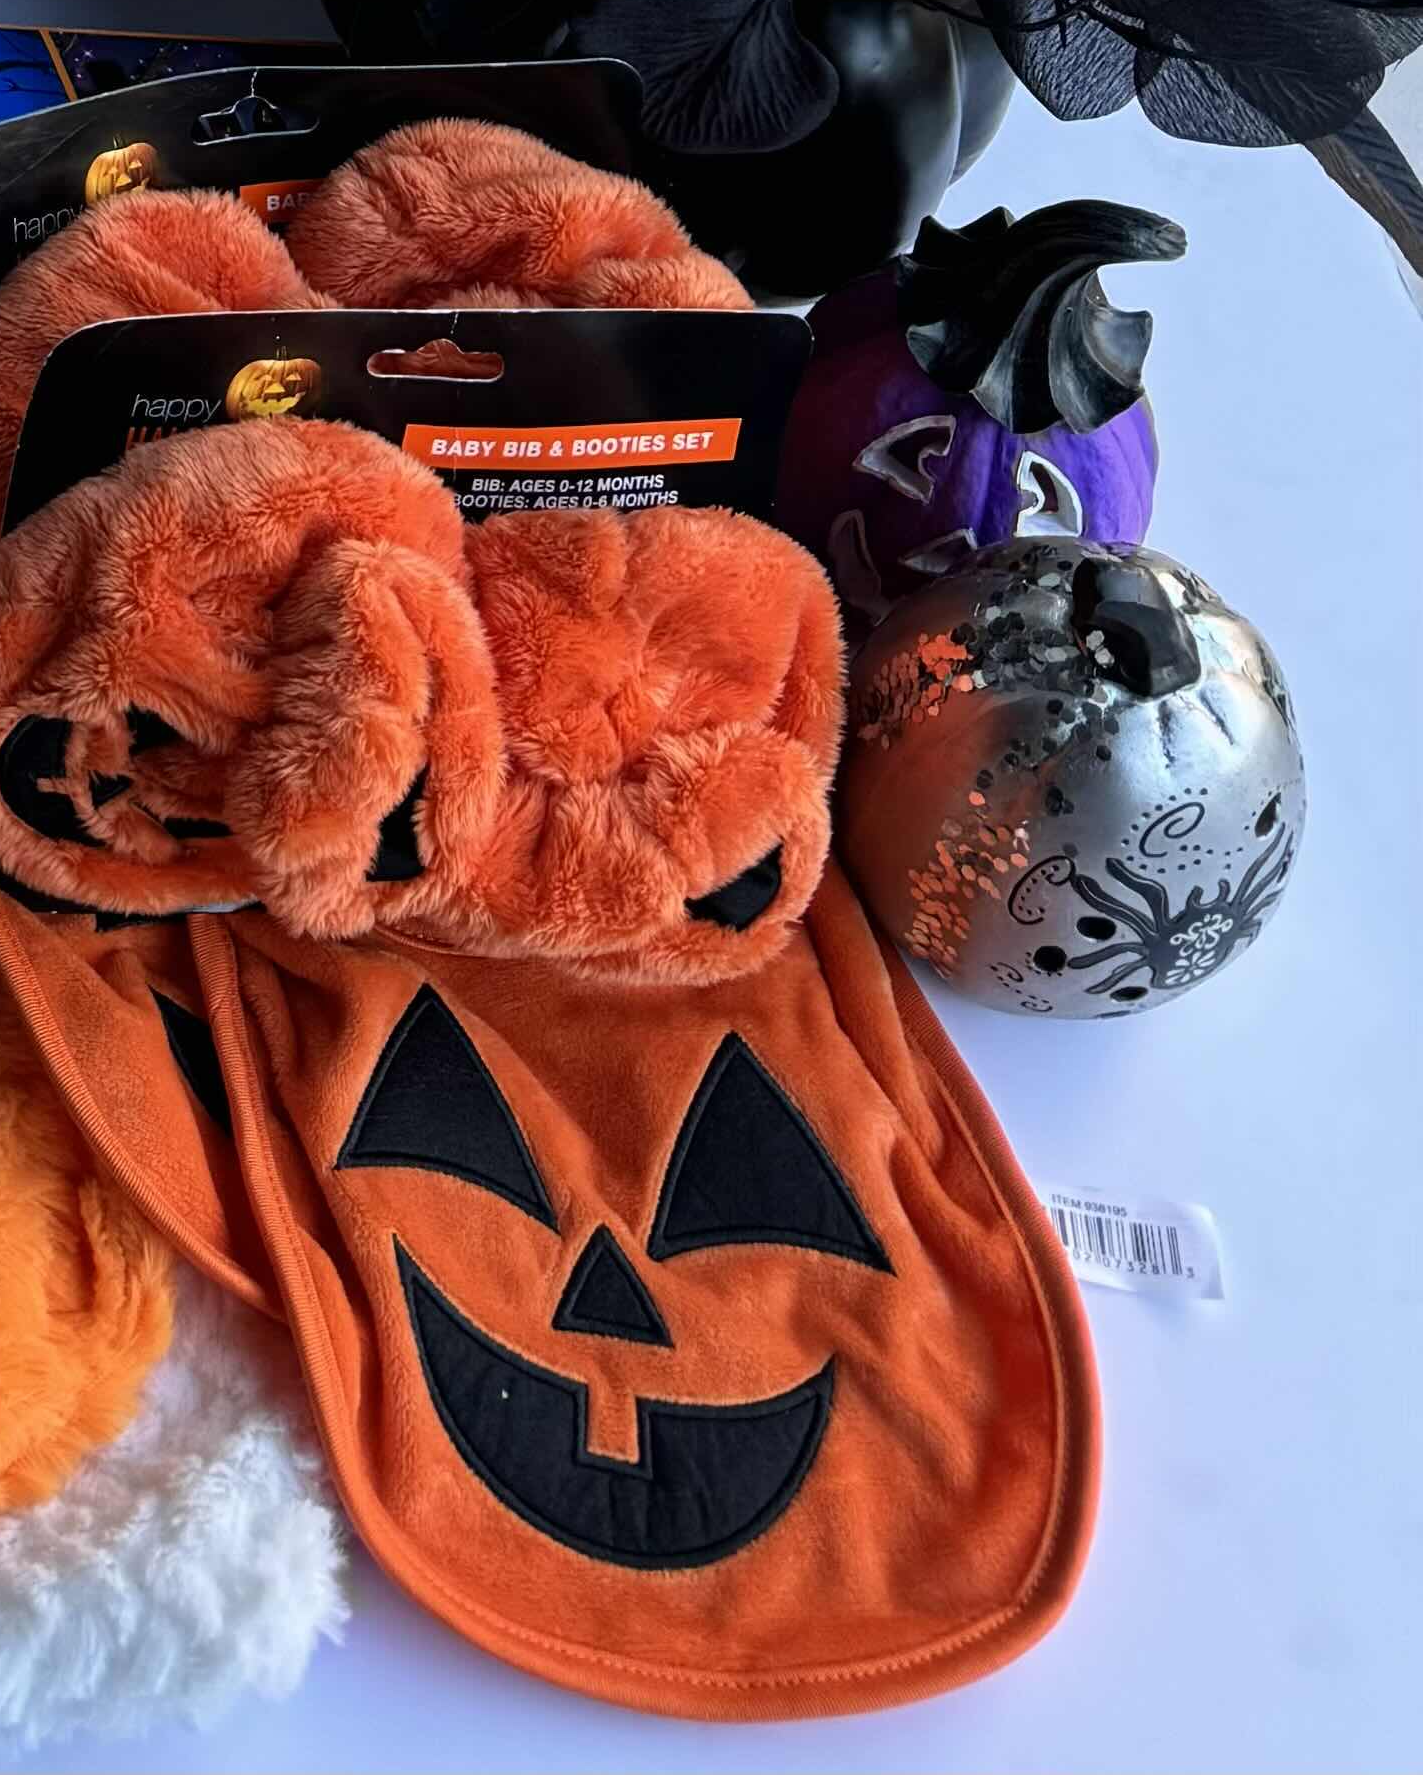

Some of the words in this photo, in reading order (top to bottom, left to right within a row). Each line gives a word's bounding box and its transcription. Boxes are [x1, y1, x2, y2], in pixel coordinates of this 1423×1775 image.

[131, 393, 222, 422] happy
[431, 436, 497, 458] BABY
[502, 437, 541, 458] BIB
[548, 438, 564, 457] &
[570, 433, 666, 455] BOOTIES
[672, 431, 714, 452] SET
[472, 478, 504, 492] BIB:
[508, 479, 555, 492] AGES
[559, 478, 594, 492] 0-12
[597, 474, 665, 492] MONTHS
[453, 494, 530, 509] BOOTIES:
[533, 494, 578, 509] AGES
[582, 493, 607, 508] 0-6
[611, 490, 679, 507] MONTHS
[1052, 1193, 1082, 1210] ITEM
